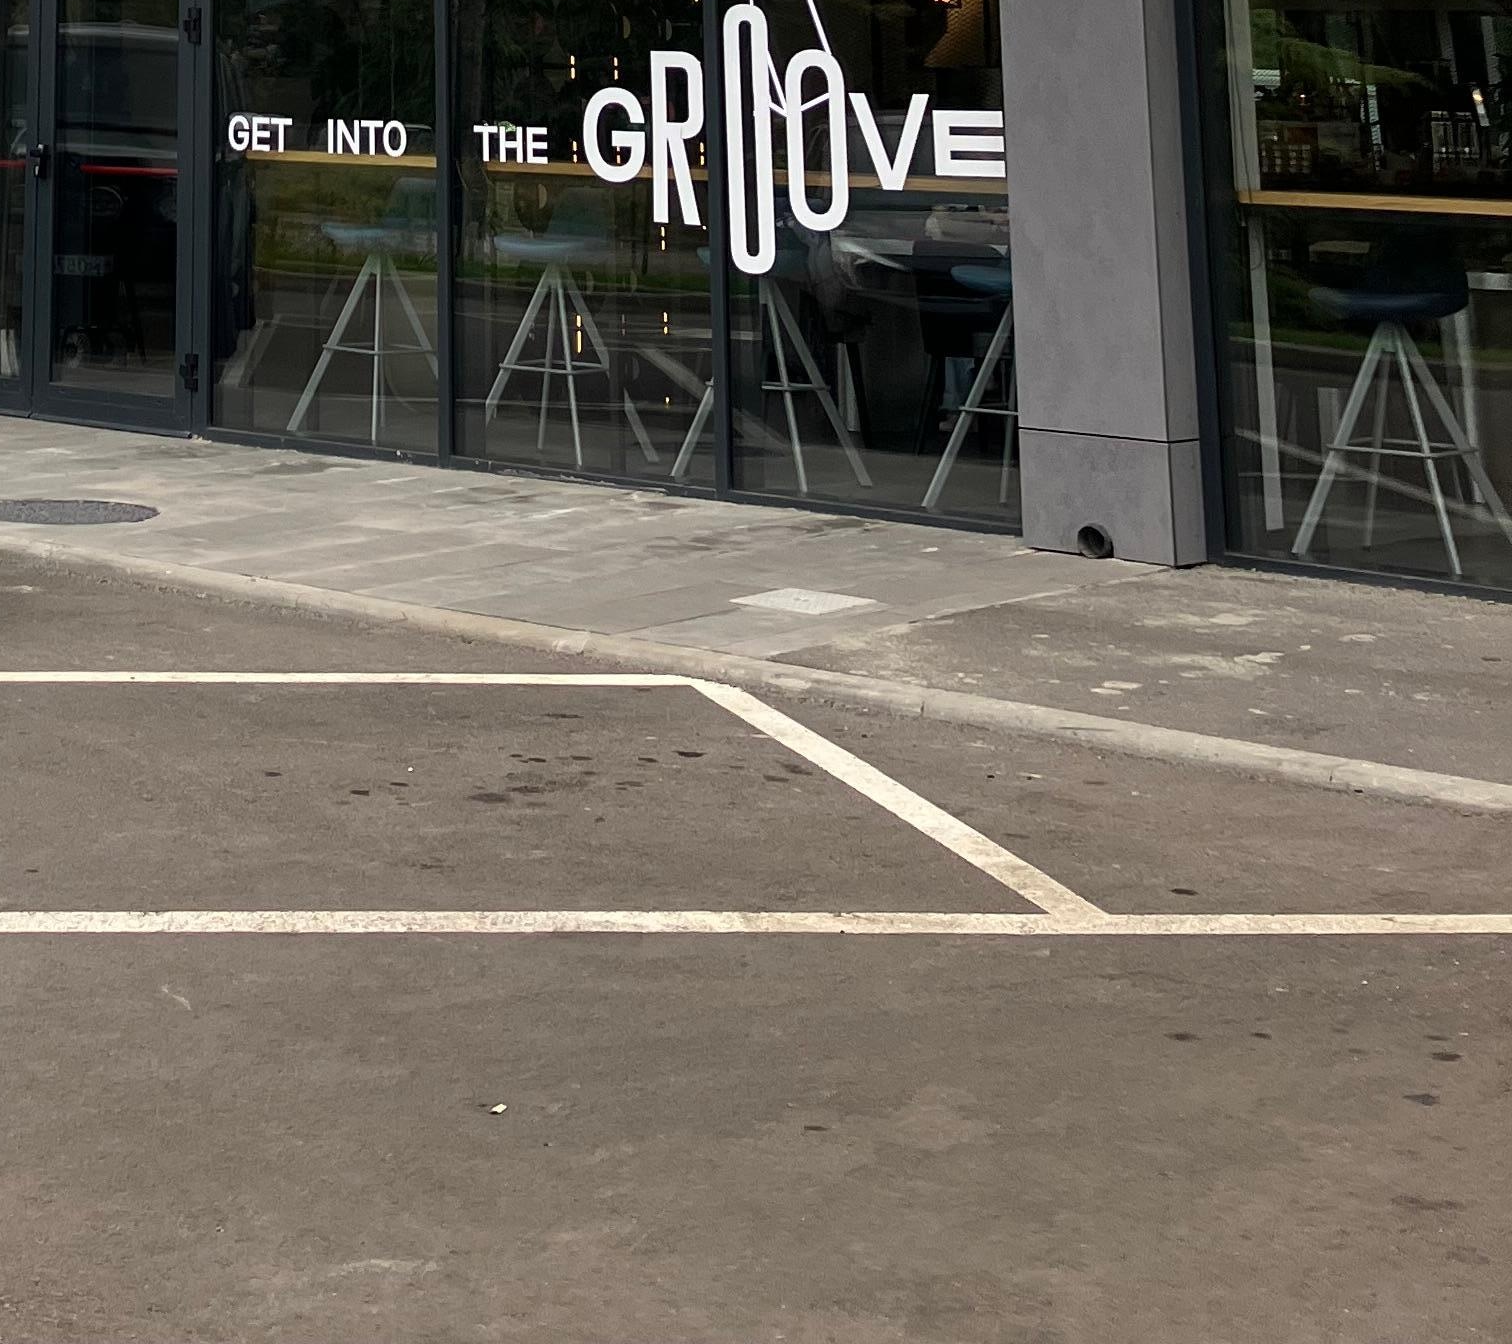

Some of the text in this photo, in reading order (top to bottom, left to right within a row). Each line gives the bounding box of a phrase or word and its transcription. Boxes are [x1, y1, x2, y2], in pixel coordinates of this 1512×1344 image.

[228, 3, 1006, 275] GET INTO THE GROOVE
